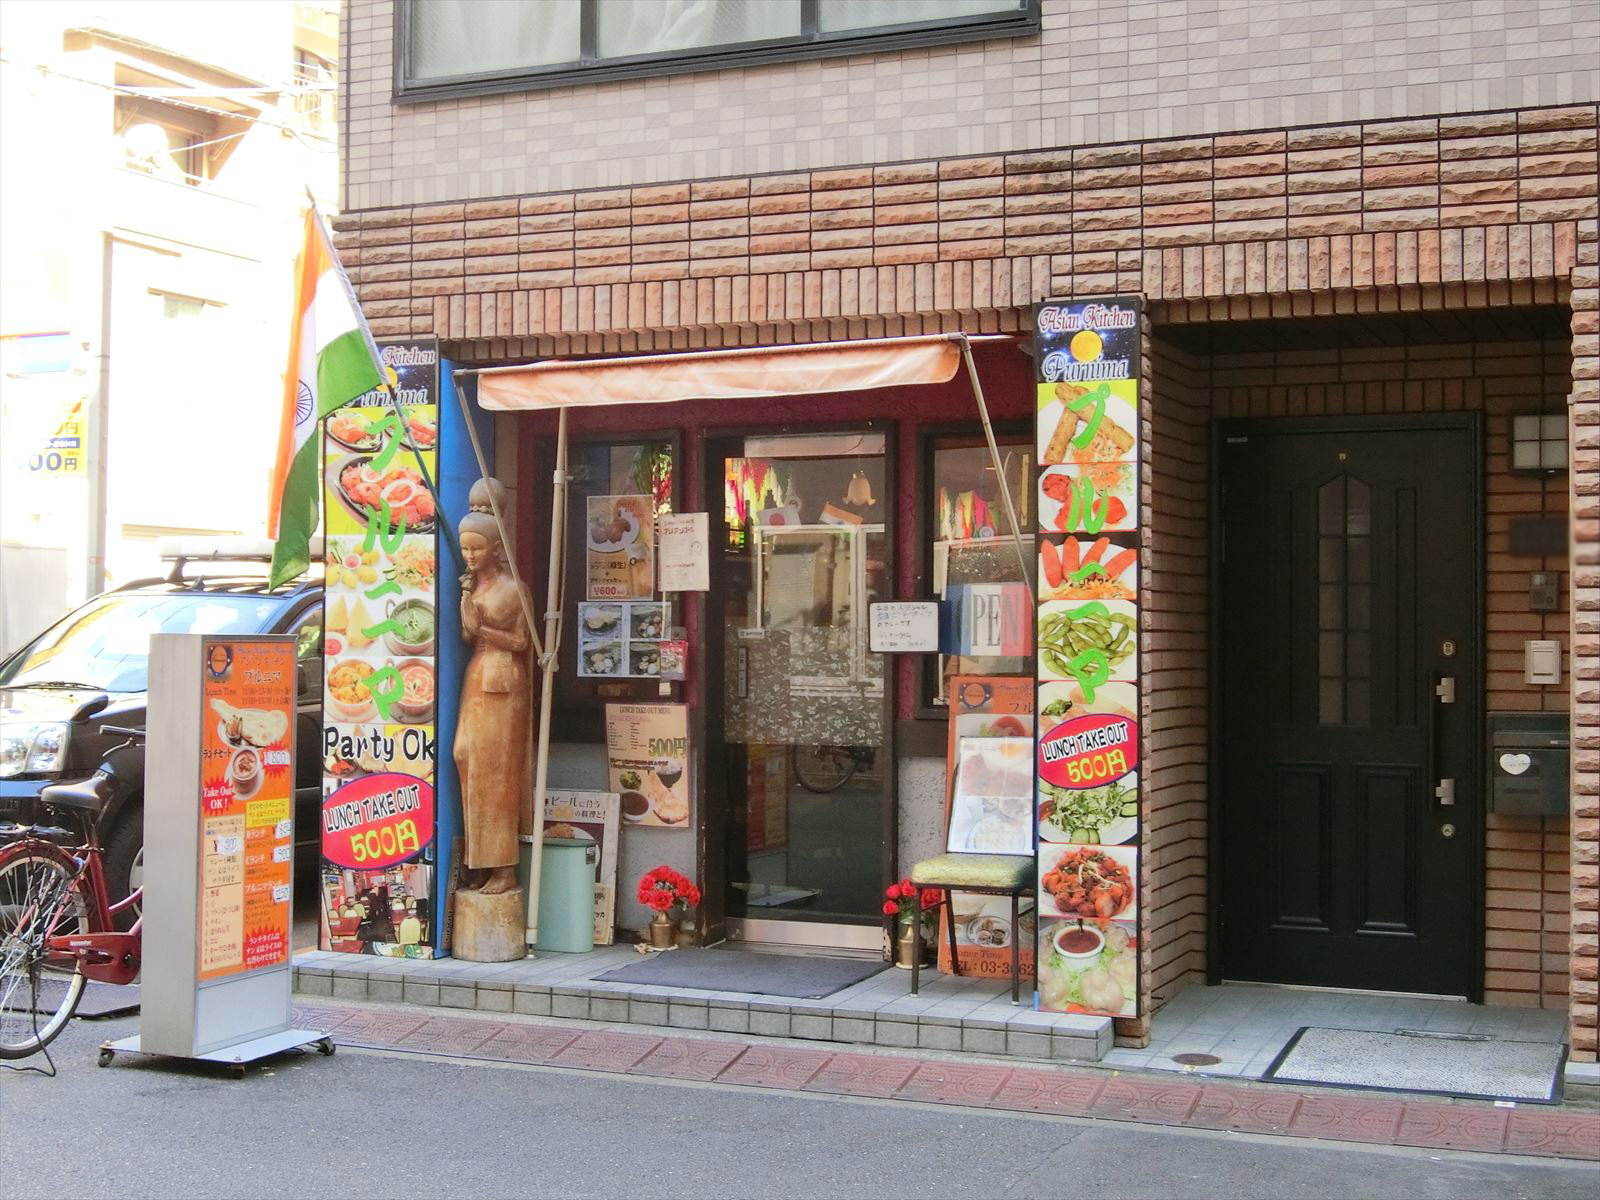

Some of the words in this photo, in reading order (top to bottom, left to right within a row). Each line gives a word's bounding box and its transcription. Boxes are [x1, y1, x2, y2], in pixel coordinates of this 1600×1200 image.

[1039, 306, 1080, 332] Asian
[1082, 304, 1136, 329] Kitchen
[381, 346, 436, 366] Kitchen
[1042, 351, 1130, 383] Purnima
[322, 727, 395, 763] Party
[402, 728, 434, 761] Ok
[648, 736, 687, 759] 500円
[1041, 735, 1078, 763] LUNCH
[1076, 728, 1108, 753] TAKE
[1106, 720, 1128, 746] OUT
[1066, 748, 1128, 783] 500円
[203, 787, 220, 798] Take
[323, 804, 361, 834] LUNCH
[363, 791, 395, 820] TAKE
[396, 784, 420, 813] OUT
[350, 819, 420, 863] 500円
